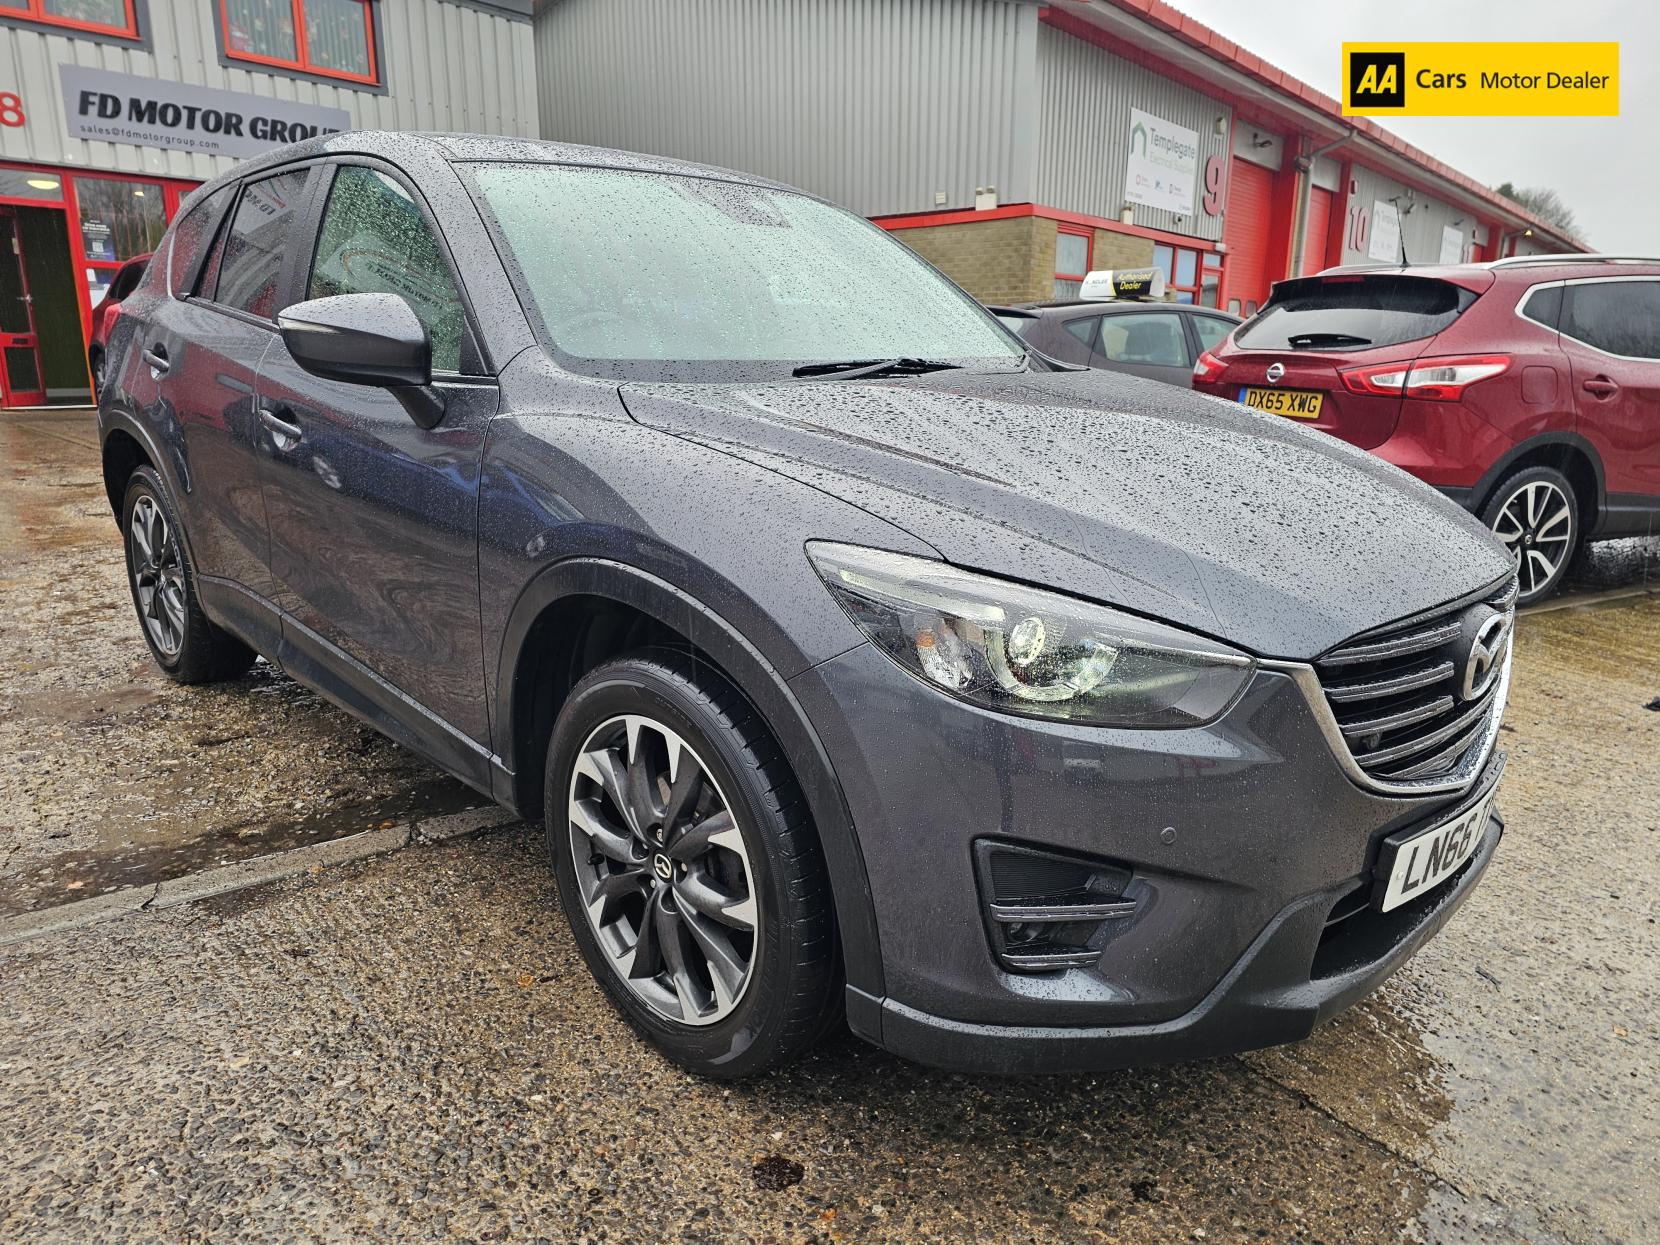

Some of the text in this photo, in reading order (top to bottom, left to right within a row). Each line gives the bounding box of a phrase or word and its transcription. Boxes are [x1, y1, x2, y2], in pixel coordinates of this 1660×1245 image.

[0, 91, 26, 127] 8
[79, 90, 122, 119] FD
[127, 97, 244, 137] MOTOR
[79, 124, 220, 150] sales@fdmotorgroup.com
[1150, 127, 1195, 159] Templegate
[1203, 155, 1225, 217] 9
[1349, 206, 1370, 252] 10
[1120, 280, 1141, 290] Dealer
[1248, 391, 1318, 413] DX65 XWG
[1401, 812, 1478, 895] LN66
